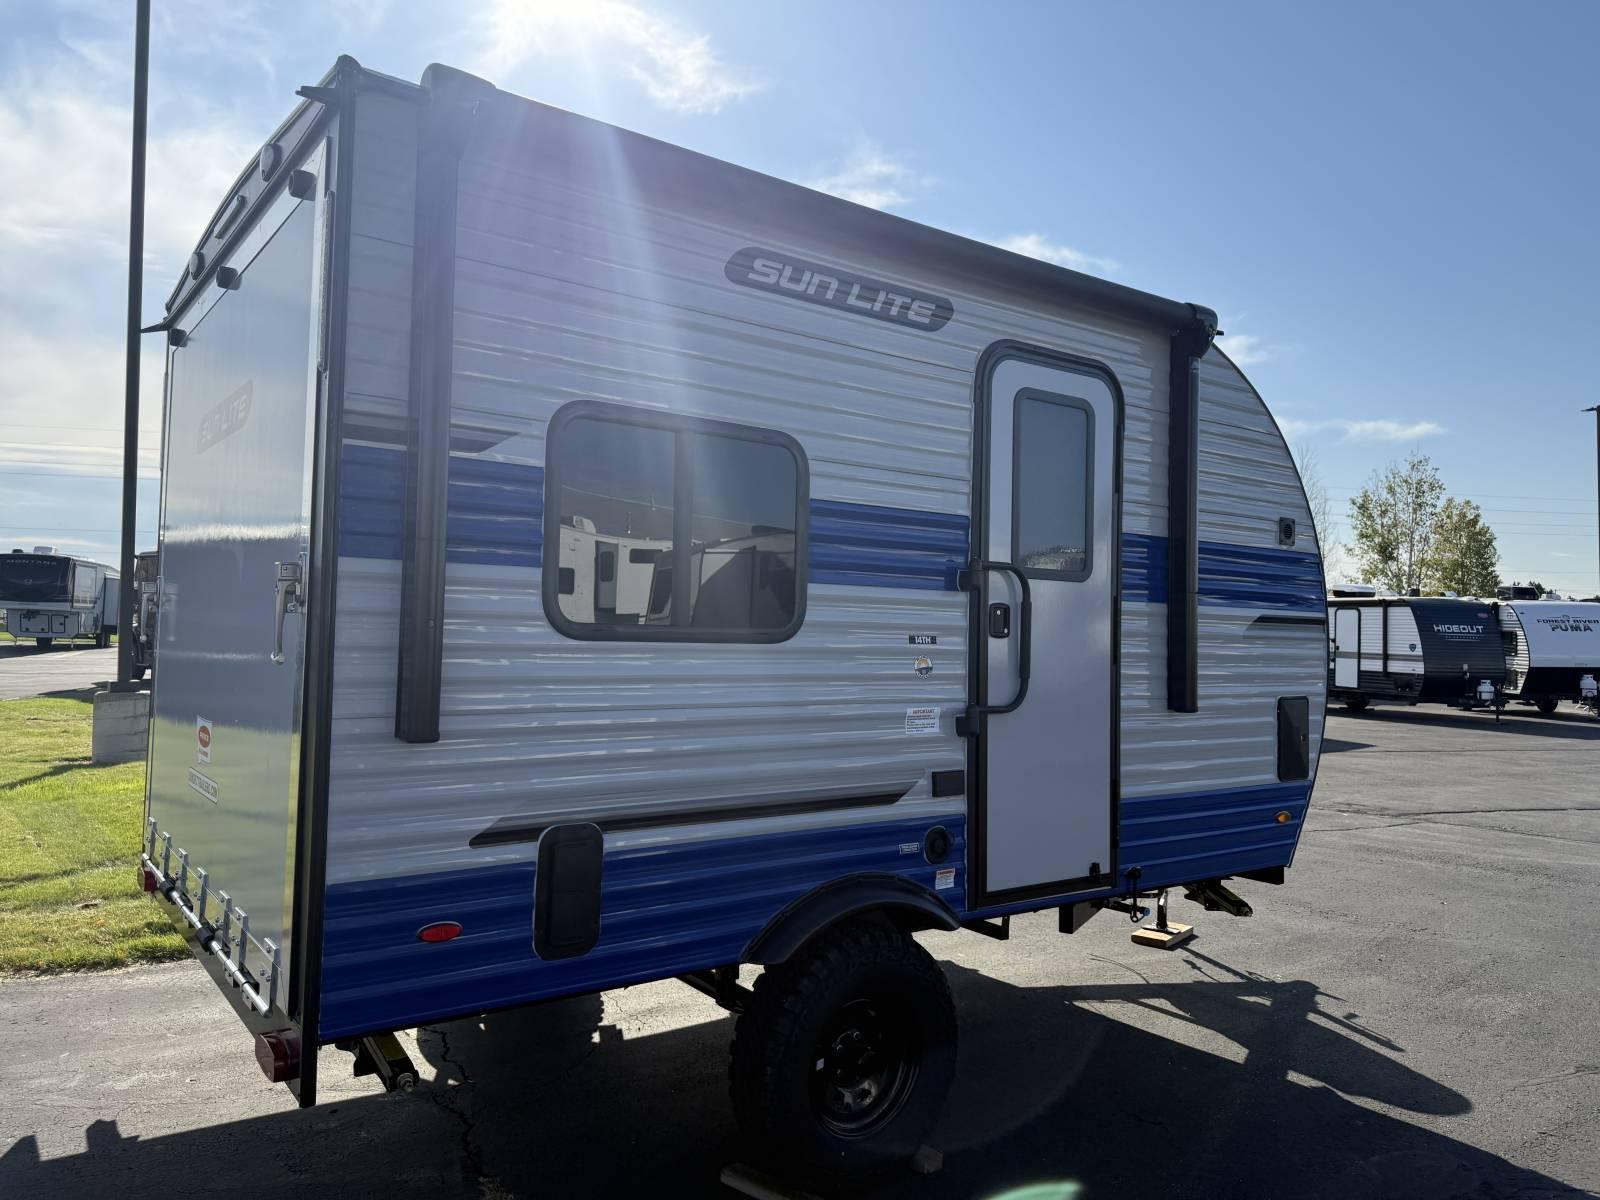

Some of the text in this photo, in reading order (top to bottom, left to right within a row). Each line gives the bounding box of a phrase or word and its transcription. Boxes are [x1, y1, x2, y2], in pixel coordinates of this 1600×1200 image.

[748, 257, 936, 324] SUN LITE
[1433, 624, 1484, 633] HIDEOUT
[1551, 624, 1593, 632] PUMA
[914, 636, 931, 644] 14TH
